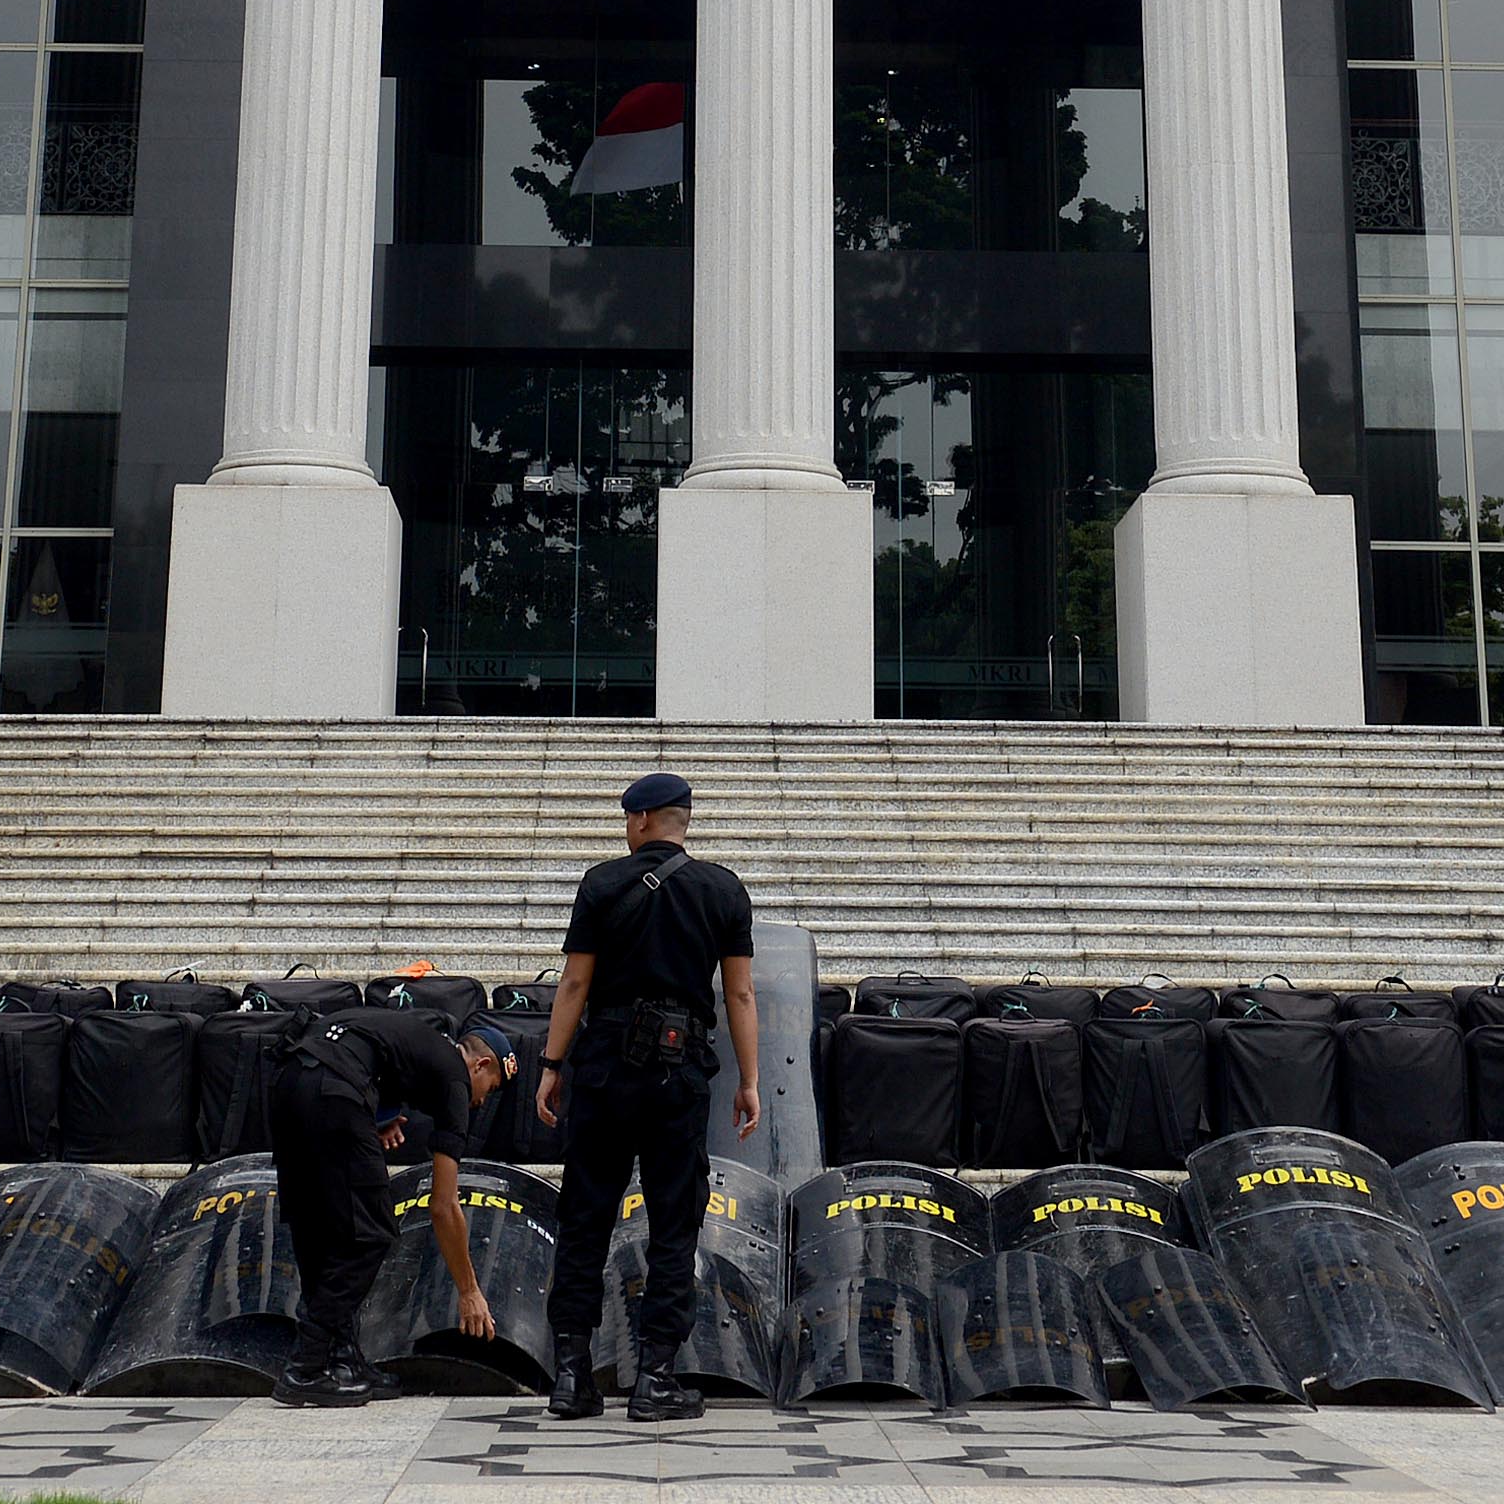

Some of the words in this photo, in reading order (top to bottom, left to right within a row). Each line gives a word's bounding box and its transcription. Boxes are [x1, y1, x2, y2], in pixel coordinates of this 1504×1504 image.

[968, 665, 1032, 683] MKRI
[1236, 1166, 1371, 1195] POLISI
[826, 1193, 957, 1224] POLISI
[1032, 1196, 1164, 1226] POLISI
